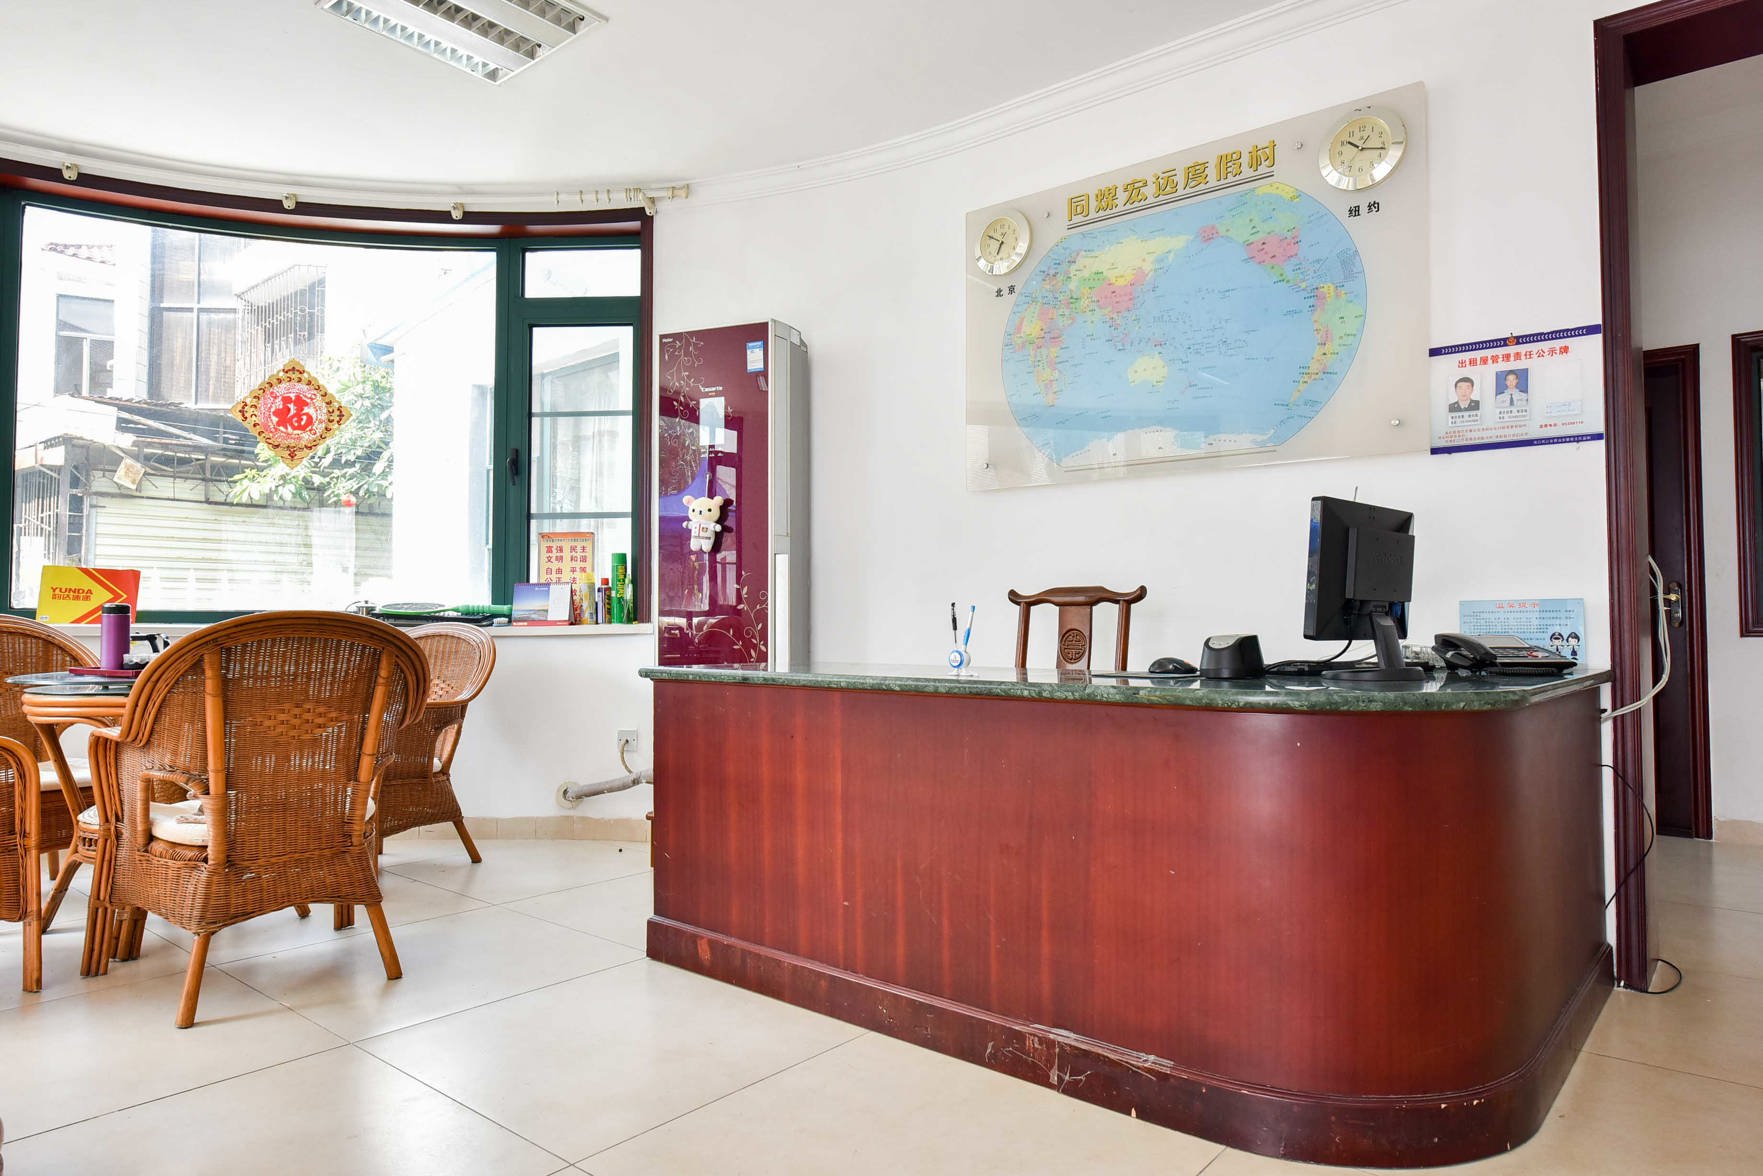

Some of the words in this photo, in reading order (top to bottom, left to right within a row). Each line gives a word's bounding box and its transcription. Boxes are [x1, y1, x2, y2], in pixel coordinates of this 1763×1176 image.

[1067, 140, 1277, 222] 同煤宏远度假村
[1348, 200, 1380, 218] 纽约
[995, 284, 1016, 298] 北京
[1457, 345, 1569, 368] 出租屋管理责任公示牌
[272, 394, 314, 432] 福
[545, 544, 564, 554] 富强
[569, 544, 588, 554] 民主
[545, 555, 564, 564] 文明
[569, 554, 588, 564] 和谐
[545, 566, 563, 576] 自由
[51, 586, 93, 595] YUNDA
